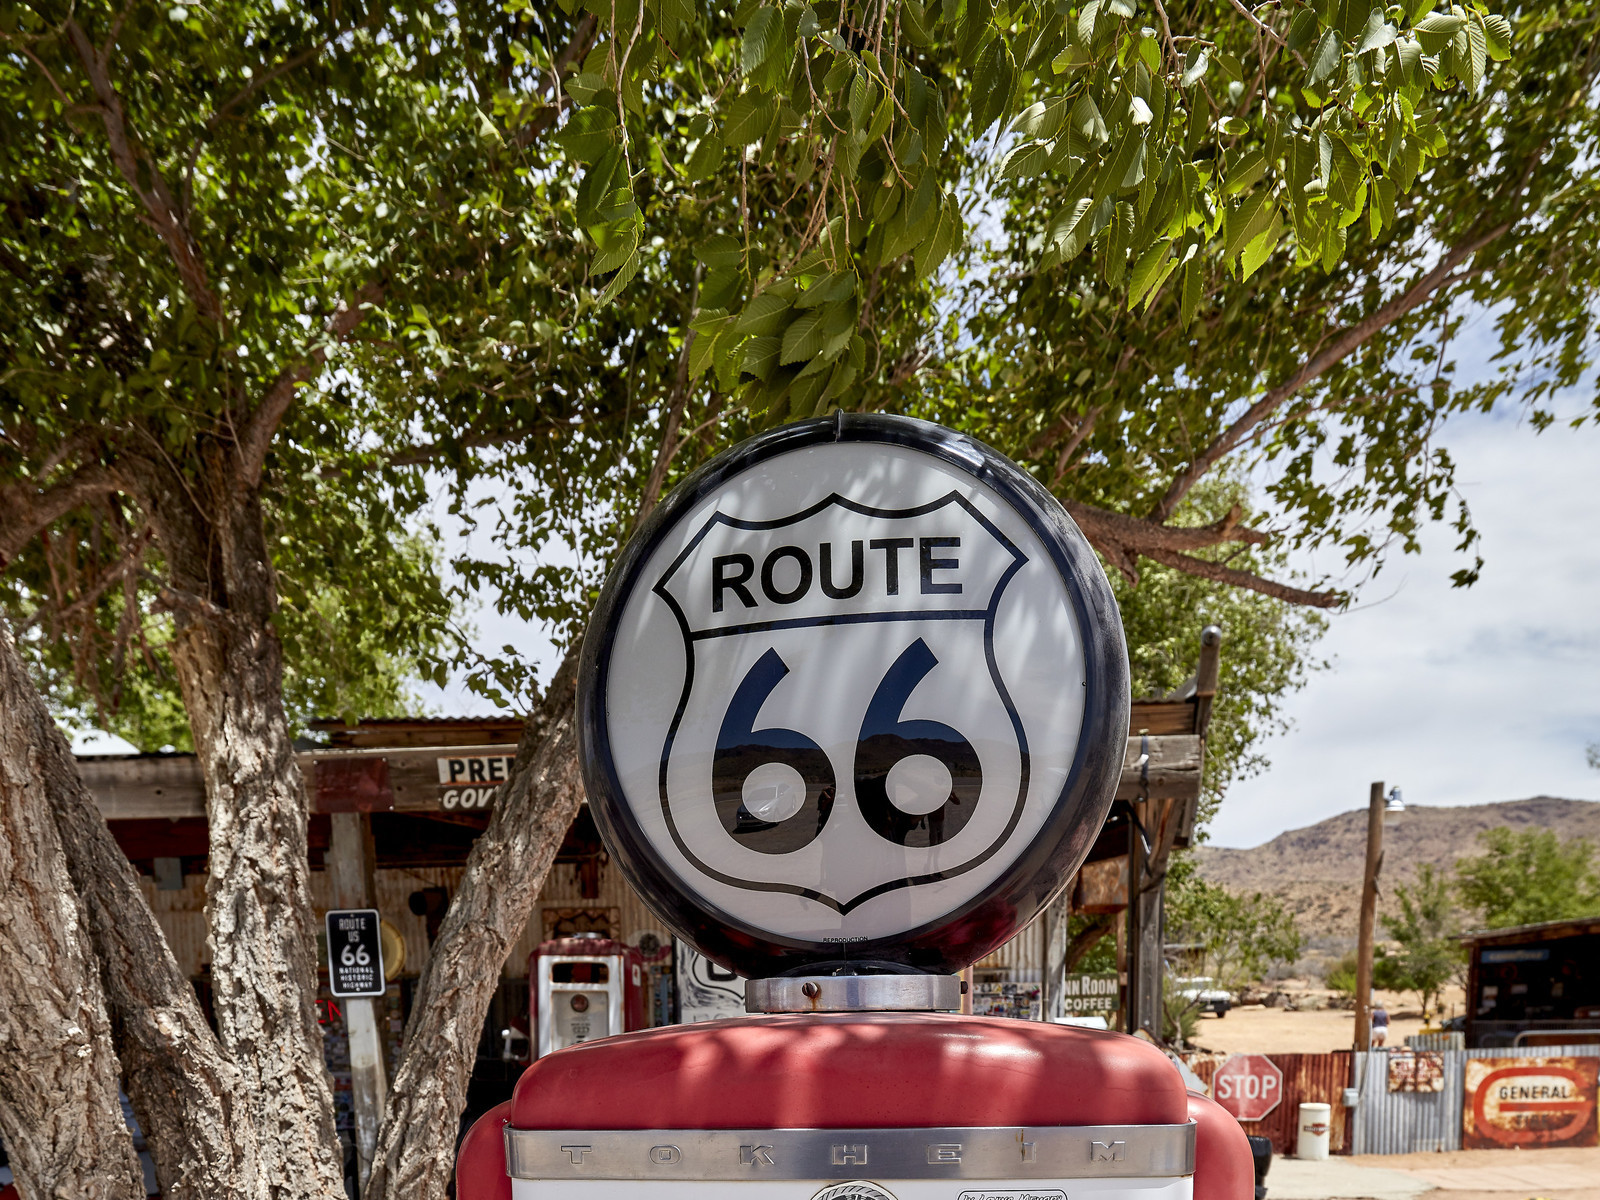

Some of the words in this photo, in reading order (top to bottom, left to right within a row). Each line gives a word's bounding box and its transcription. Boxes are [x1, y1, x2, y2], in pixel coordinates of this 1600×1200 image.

[711, 536, 963, 613] ROUTE
[711, 636, 983, 855] 66
[339, 917, 367, 930] ROUTE
[347, 930, 360, 942] US
[341, 944, 371, 966] 66
[339, 966, 375, 974] NATIONAL
[340, 973, 374, 981] HISTORIC
[342, 981, 373, 989] HIGHWAY
[1081, 975, 1118, 995] ROOM
[1065, 997, 1112, 1011] COFFEE
[1217, 1074, 1278, 1100] STOP
[1499, 1085, 1570, 1100] GENERAL
[560, 1140, 1126, 1166] TOKHEIM
